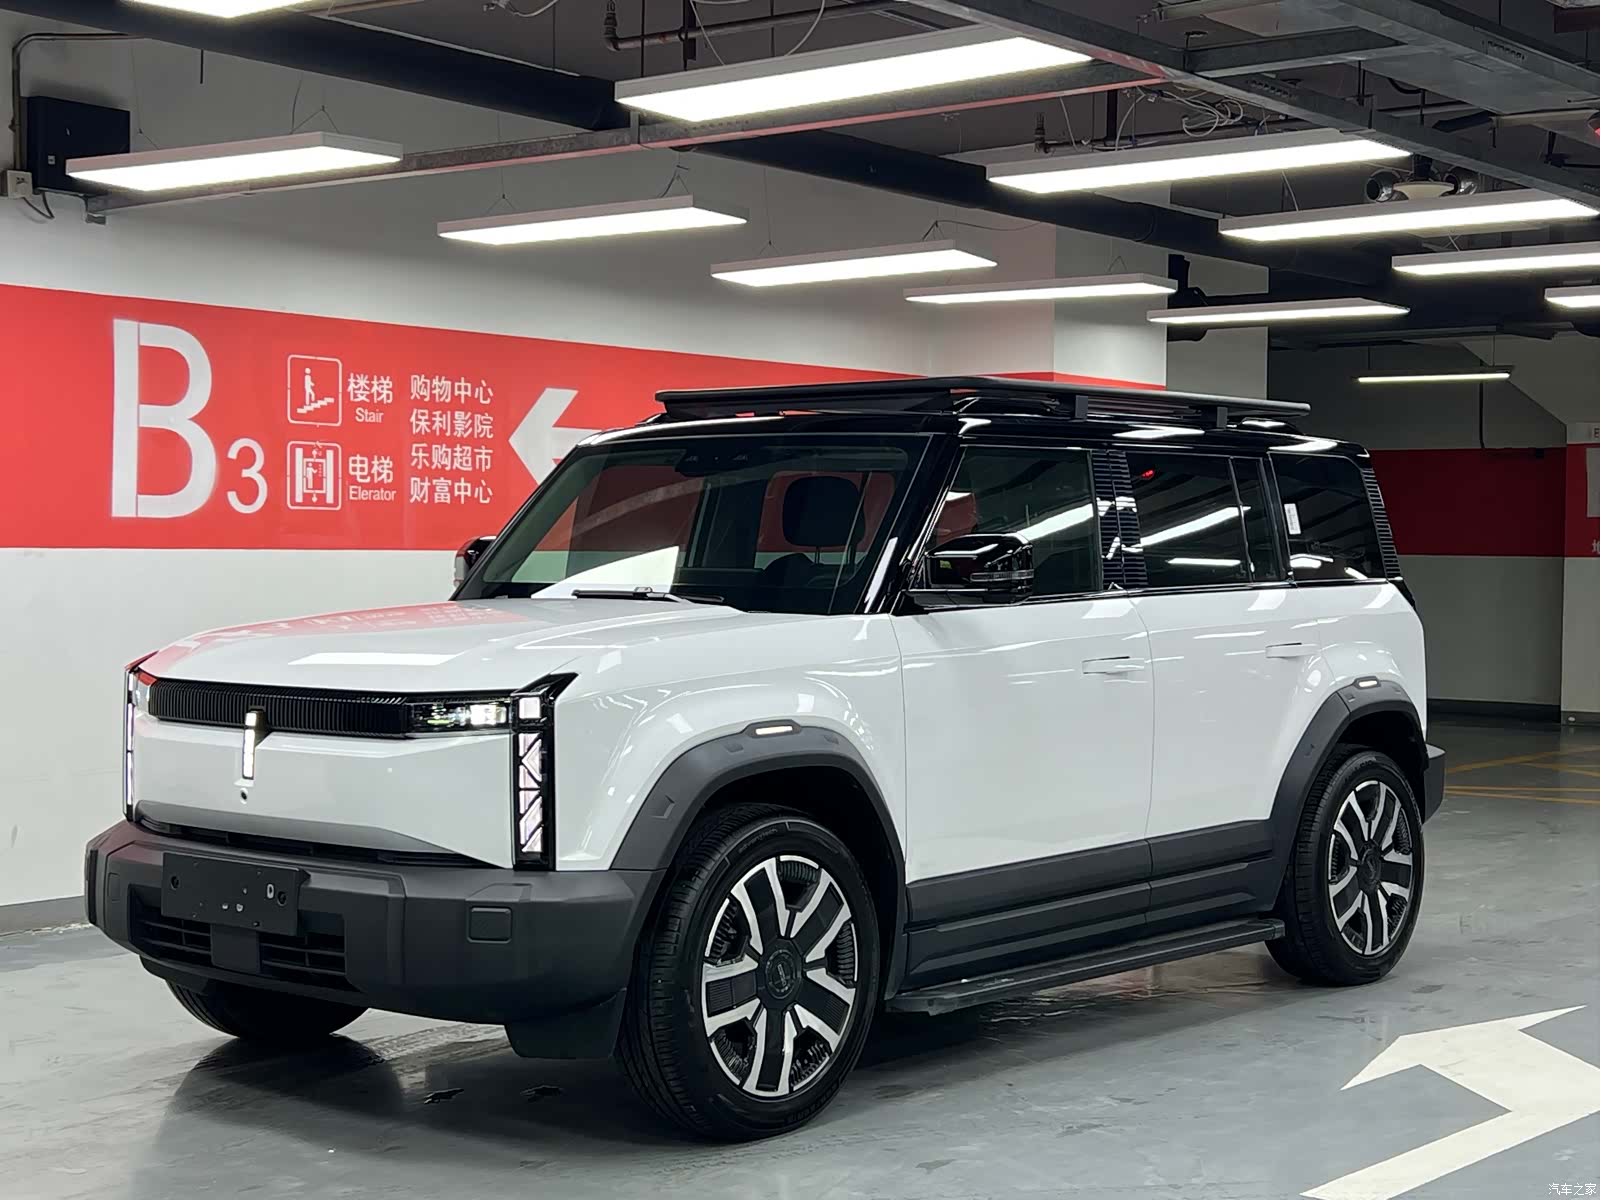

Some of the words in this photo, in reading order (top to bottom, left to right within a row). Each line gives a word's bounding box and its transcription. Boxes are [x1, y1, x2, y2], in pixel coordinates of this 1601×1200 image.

[347, 373, 393, 404] 楼梯
[410, 374, 494, 404] 购物中心
[355, 407, 384, 423] Stair
[410, 408, 494, 439] 保利影院
[348, 454, 394, 484] 电梯
[410, 443, 494, 472] 乐购超市
[349, 485, 397, 501] Elerator
[409, 476, 494, 504] 财富中心
